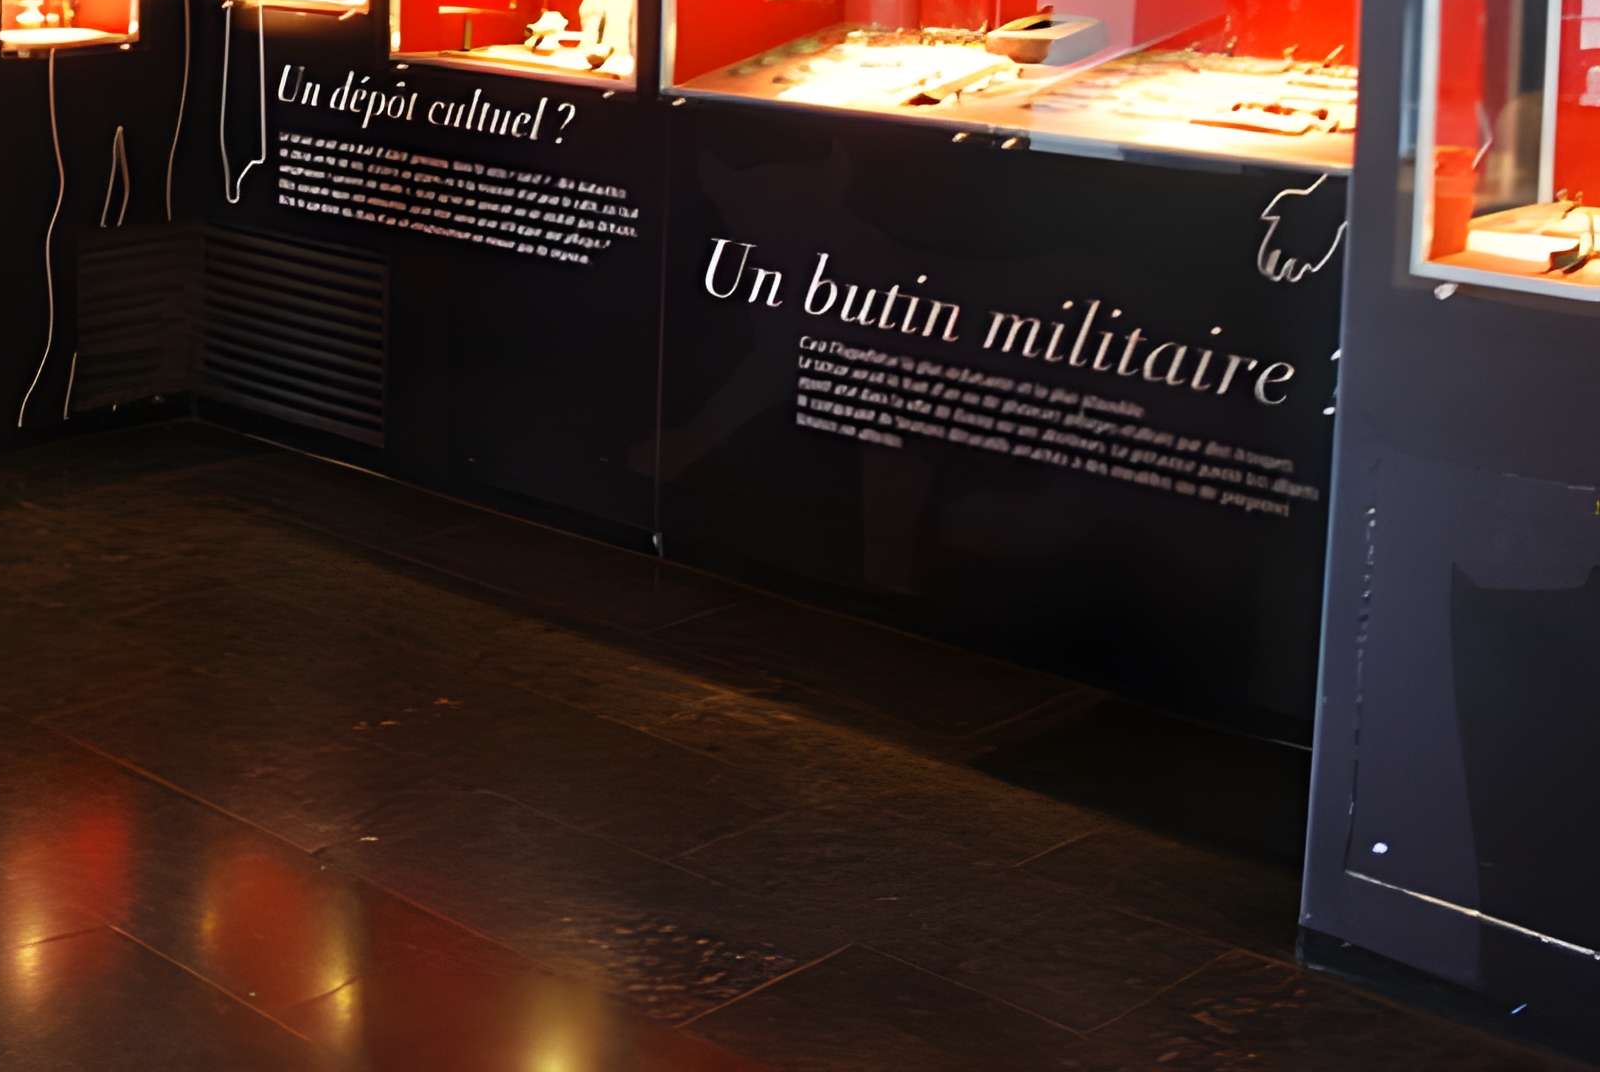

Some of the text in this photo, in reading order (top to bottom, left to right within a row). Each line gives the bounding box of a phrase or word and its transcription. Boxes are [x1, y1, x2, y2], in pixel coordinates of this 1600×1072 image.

[277, 63, 321, 108] Un
[329, 70, 419, 130] dépôt
[427, 88, 549, 141] cultuel
[704, 237, 784, 308] Un
[803, 251, 960, 343] butin
[983, 299, 1296, 406] militaire
